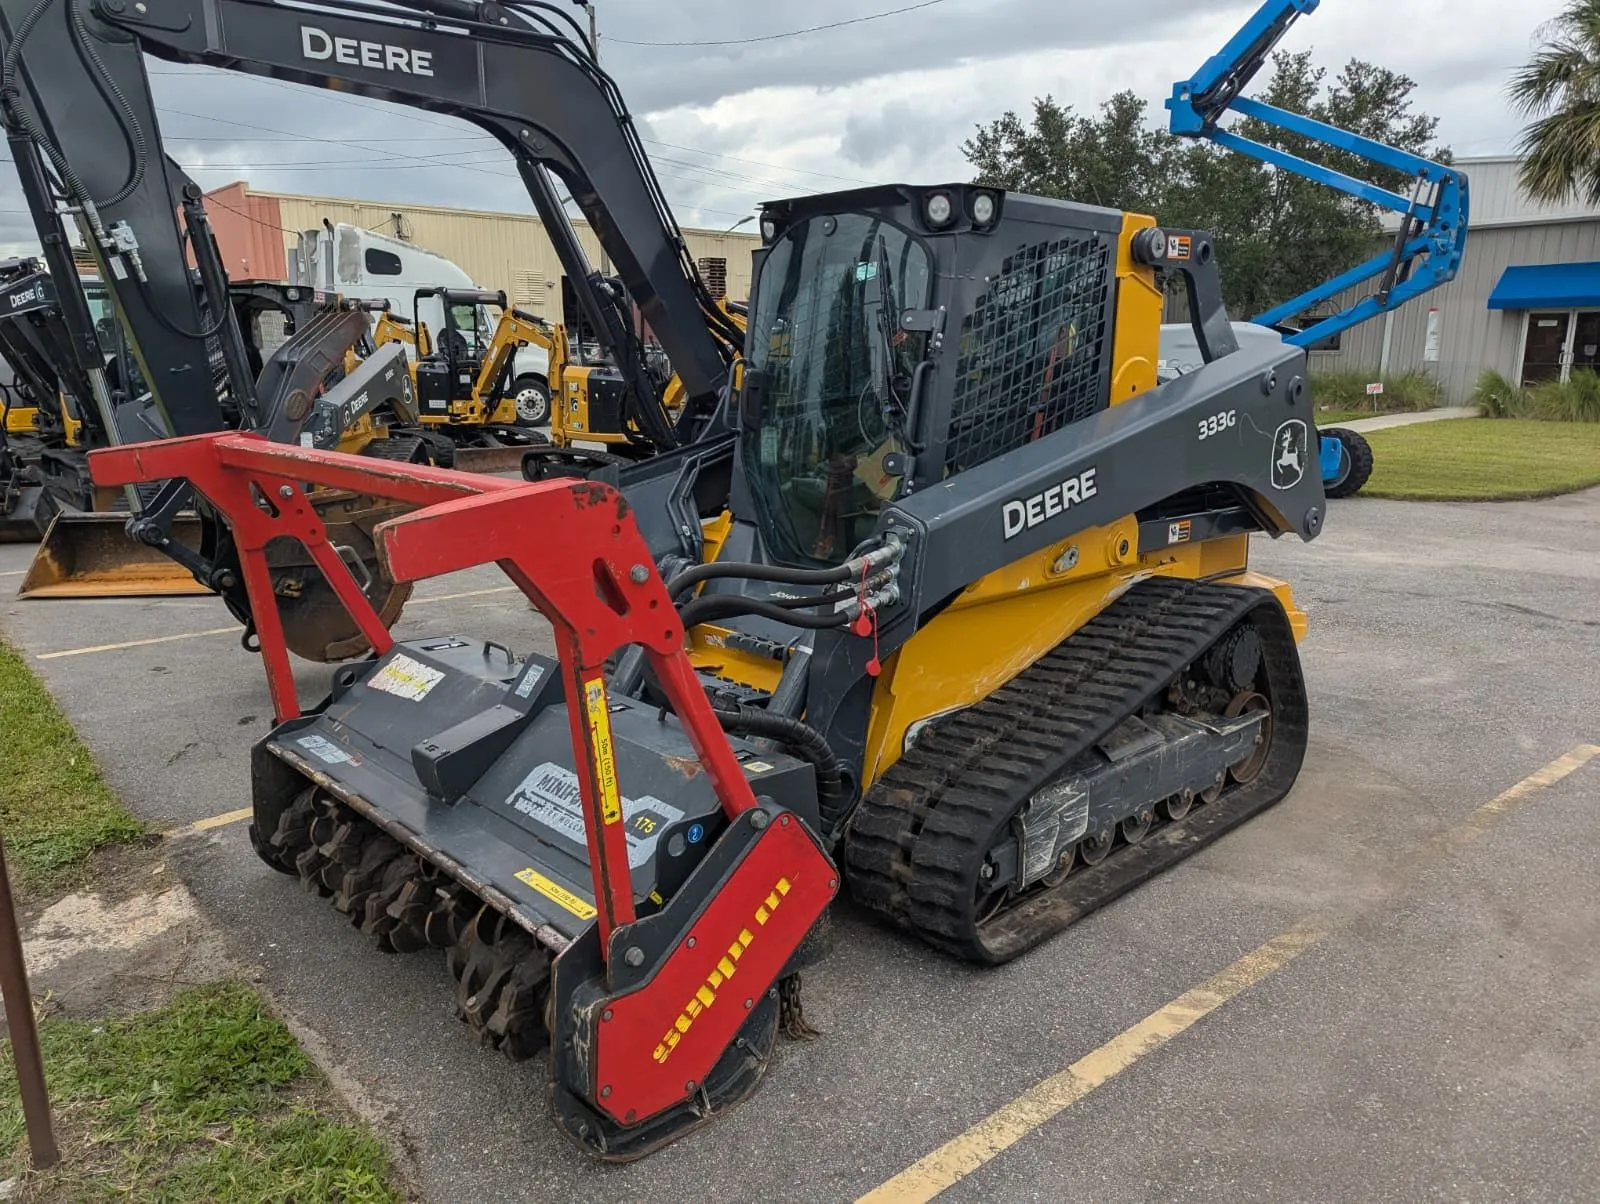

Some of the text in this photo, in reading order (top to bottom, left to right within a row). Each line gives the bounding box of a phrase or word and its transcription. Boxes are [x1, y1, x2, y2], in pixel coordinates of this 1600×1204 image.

[301, 25, 434, 77] DEERE
[10, 288, 36, 308] DEERE
[350, 391, 369, 415] DEERE
[1198, 409, 1236, 441] 333G
[1002, 467, 1097, 540] DEERE
[536, 774, 582, 807] MINIFO
[634, 815, 657, 833] 175
